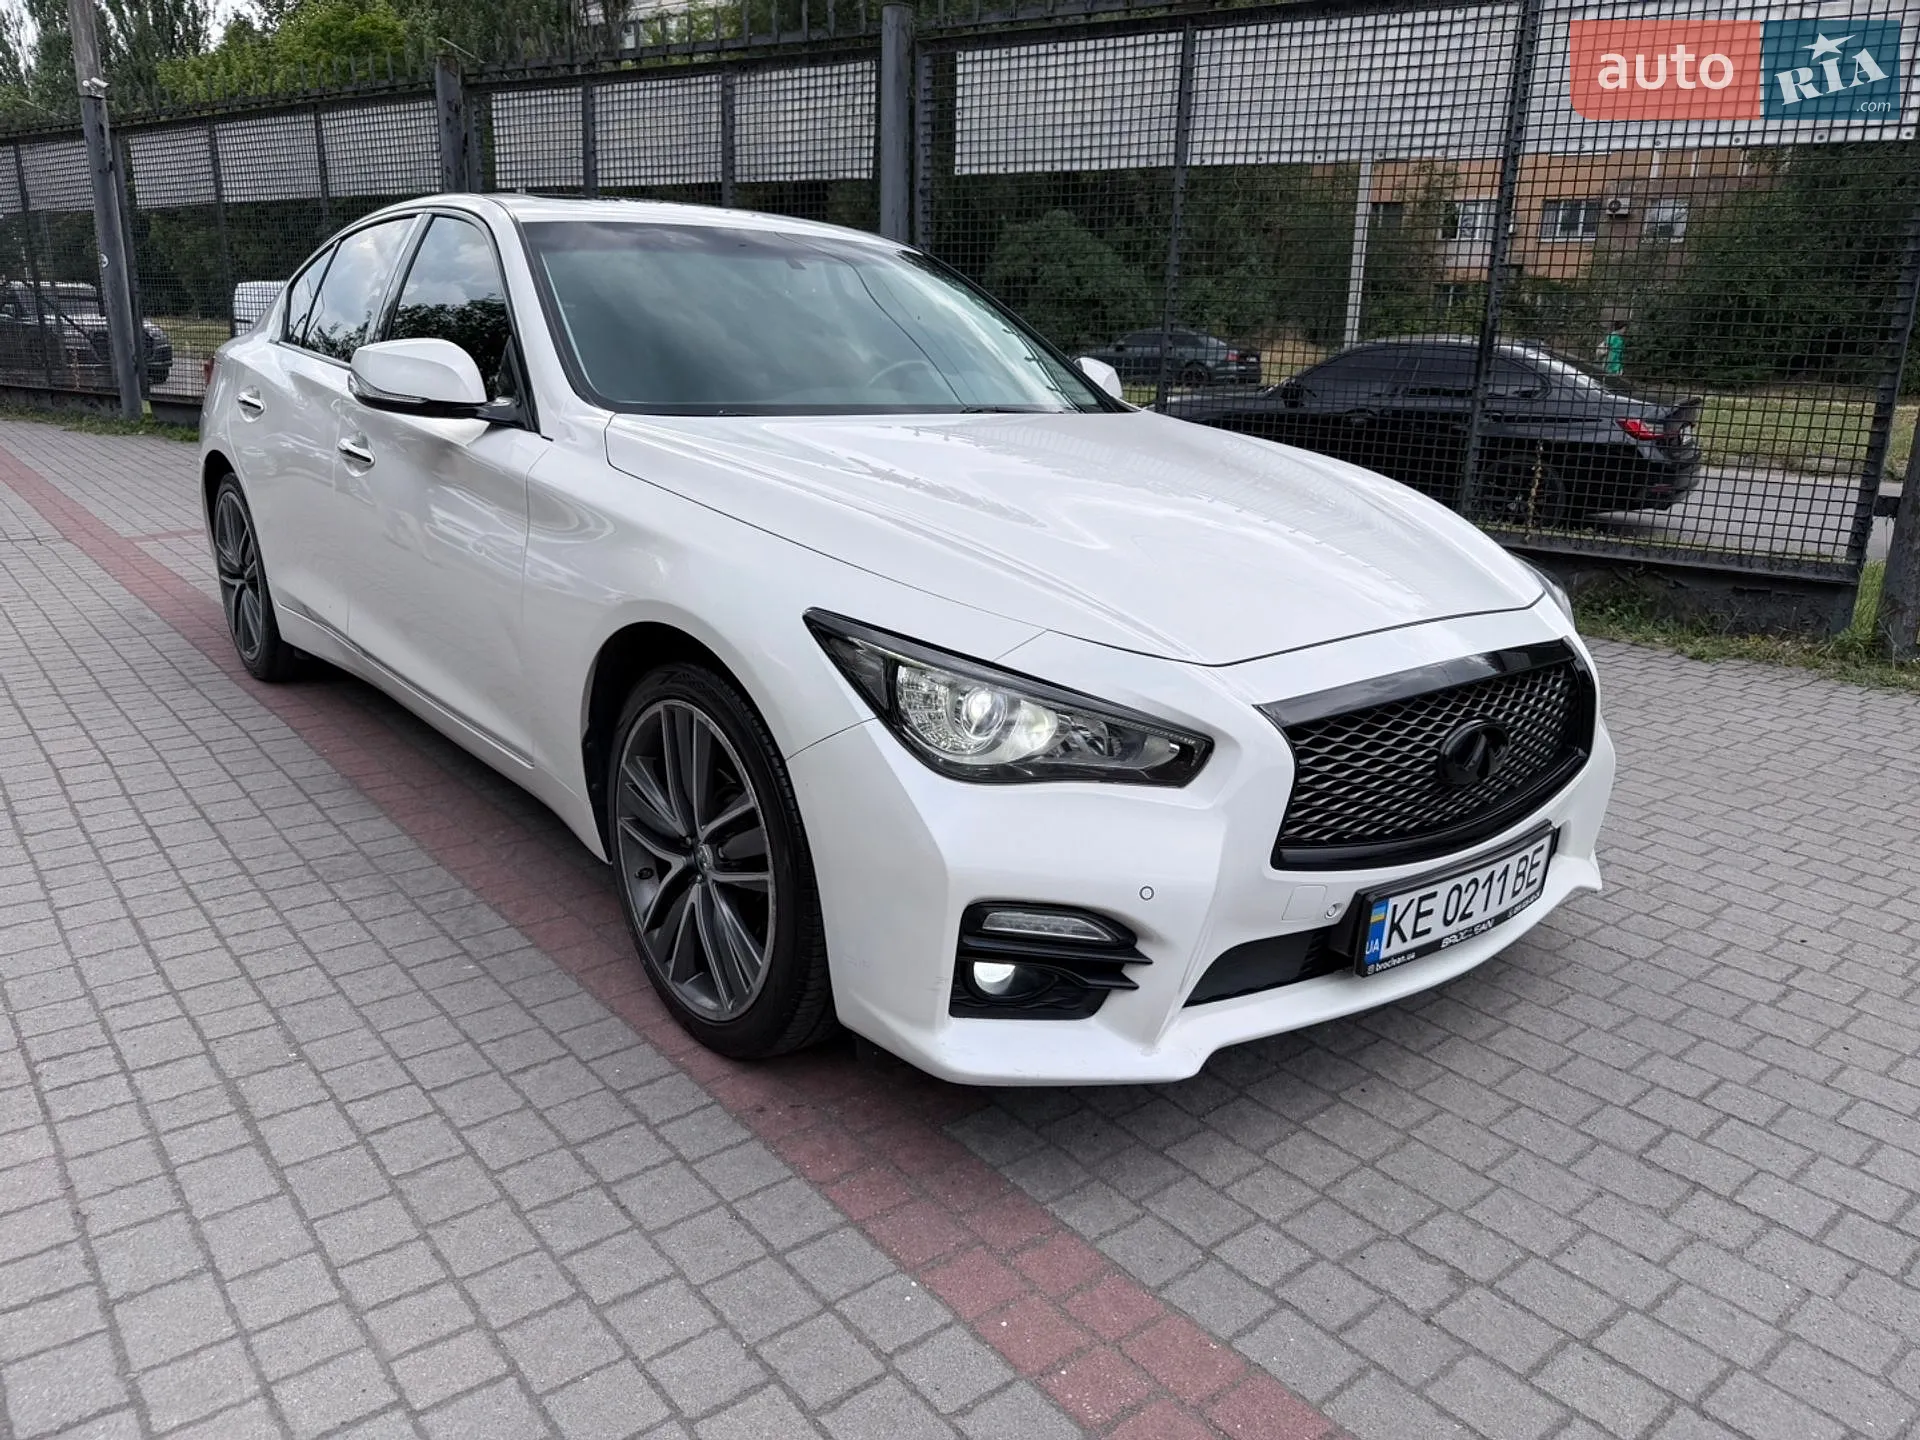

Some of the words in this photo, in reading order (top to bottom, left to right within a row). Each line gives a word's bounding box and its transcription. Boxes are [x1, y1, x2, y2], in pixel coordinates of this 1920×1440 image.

[1386, 890, 1438, 948] KE
[1442, 863, 1510, 927] 0211
[1511, 843, 1545, 898] BE
[1365, 938, 1380, 954] UA
